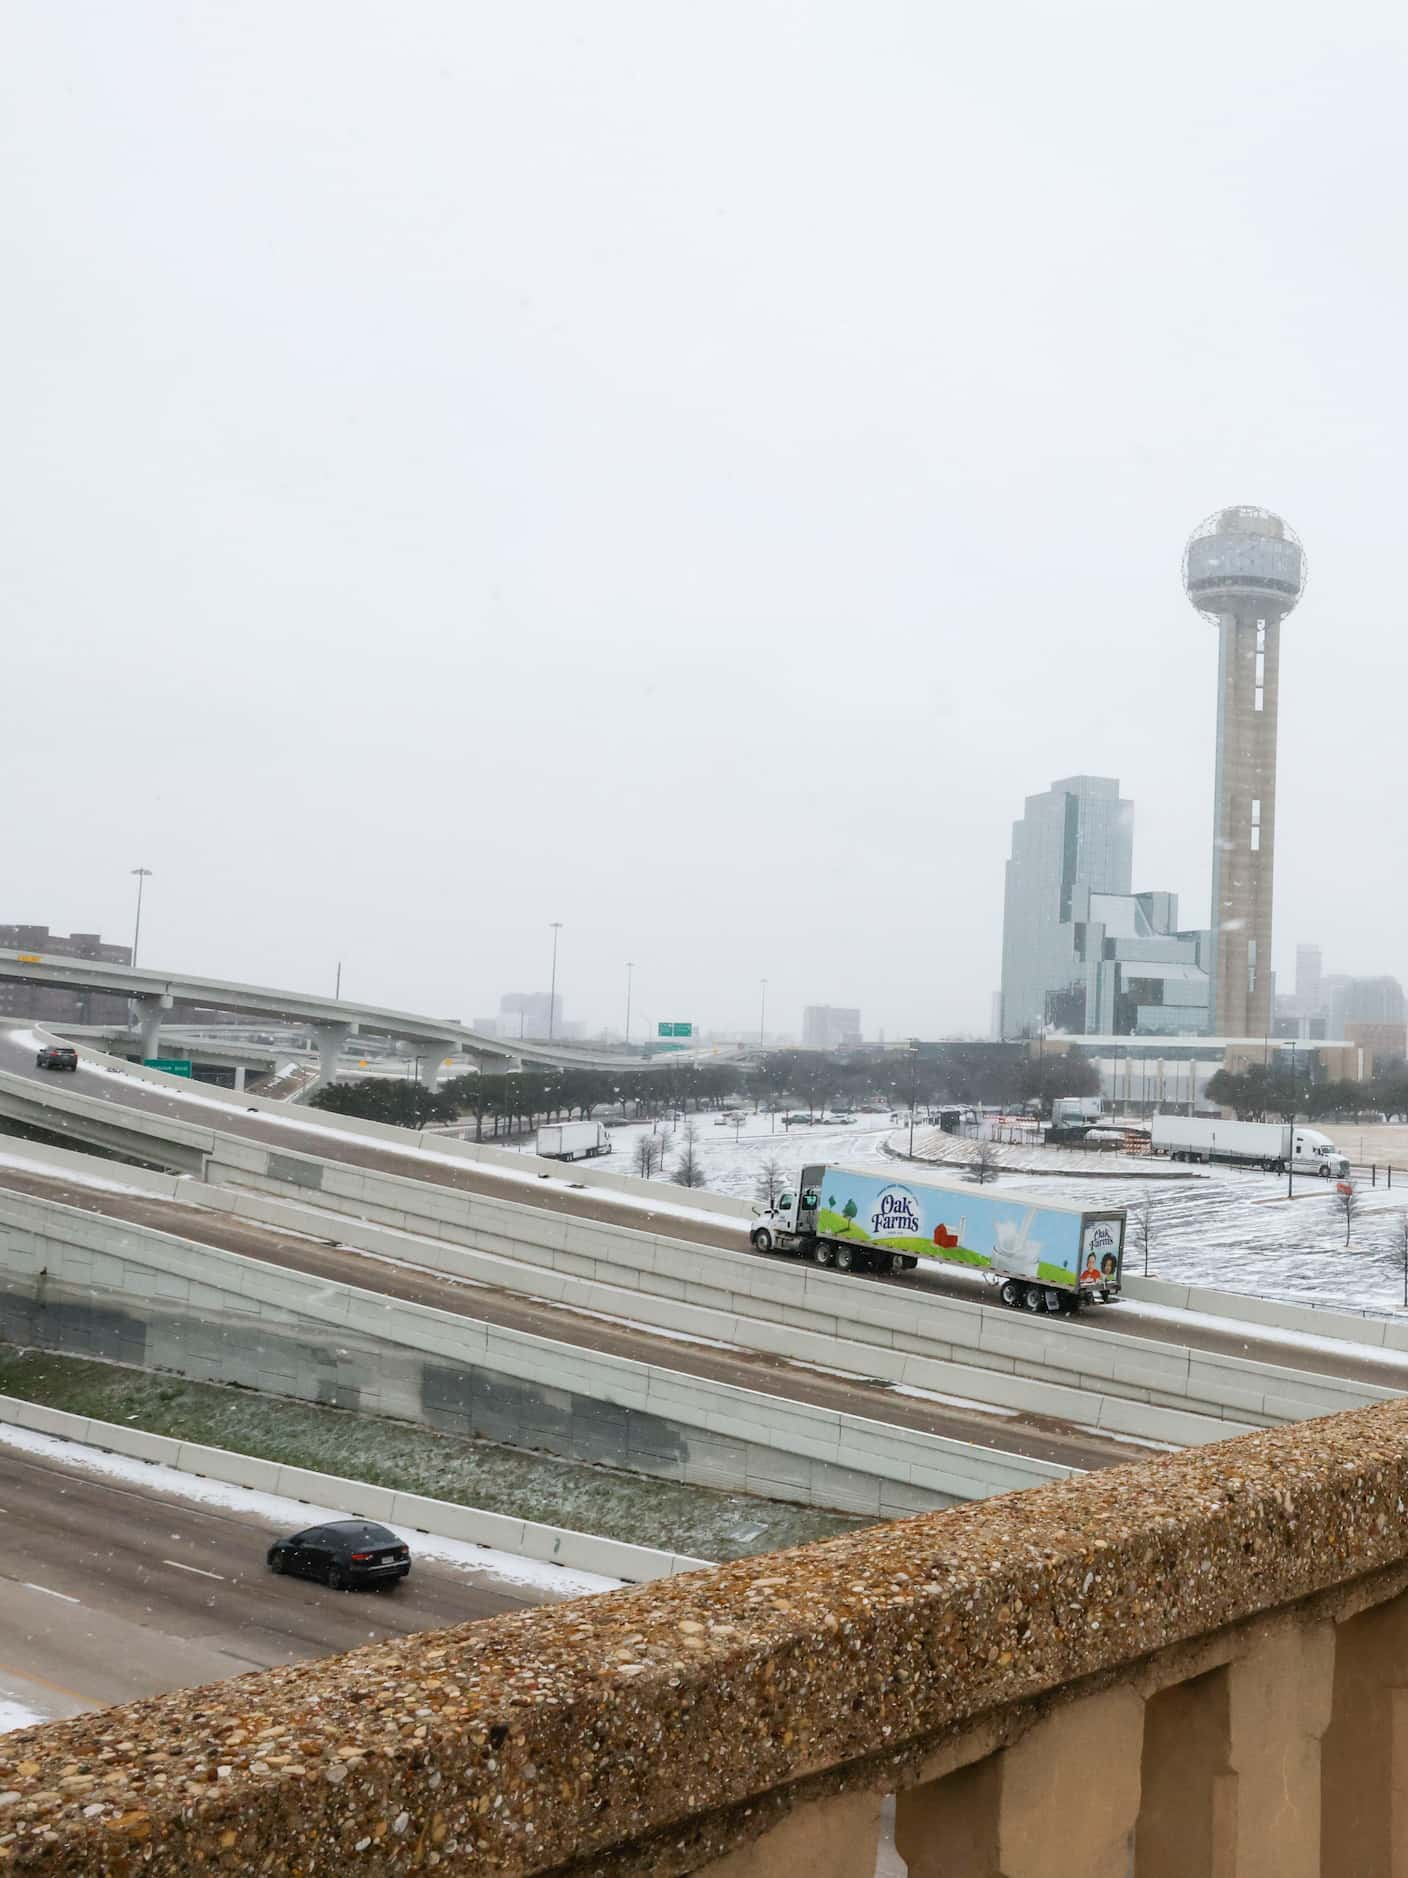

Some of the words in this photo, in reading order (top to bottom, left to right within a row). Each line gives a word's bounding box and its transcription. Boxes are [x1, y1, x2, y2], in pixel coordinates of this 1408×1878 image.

[881, 1194, 914, 1217] Oak
[871, 1212, 919, 1233] Farms
[1094, 1228, 1111, 1241] Oak
[1089, 1238, 1114, 1250] Farms
